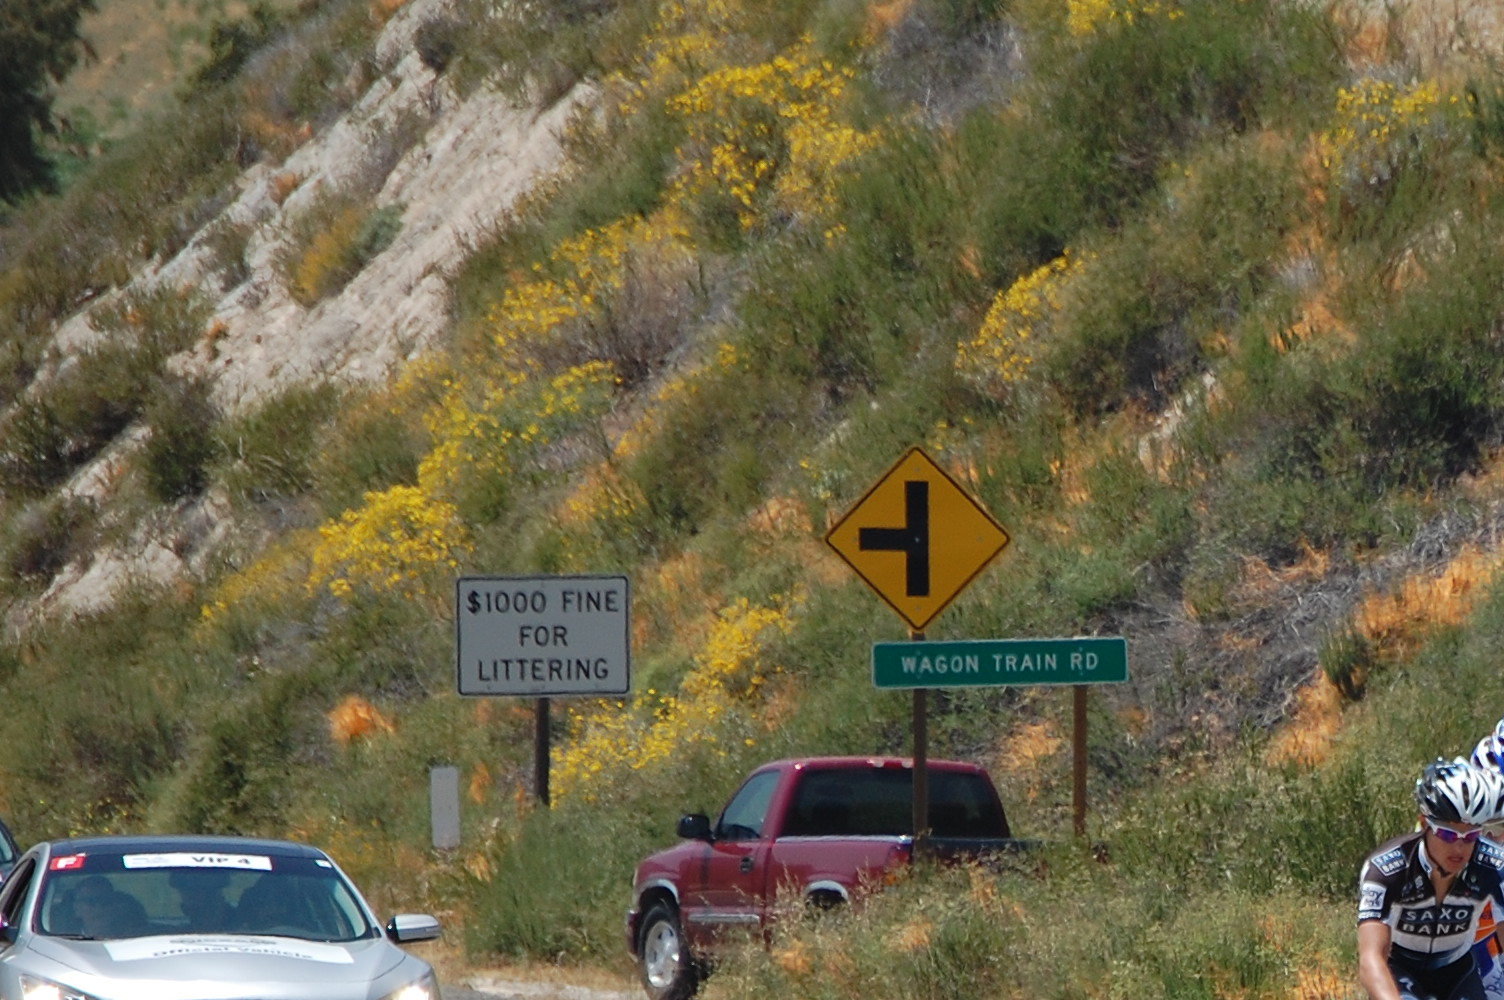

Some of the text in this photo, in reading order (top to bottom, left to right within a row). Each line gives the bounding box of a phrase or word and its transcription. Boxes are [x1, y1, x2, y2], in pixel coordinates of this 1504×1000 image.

[467, 590, 619, 614] $1000 FINE
[519, 625, 568, 647] FOR
[478, 658, 609, 682] LITTERING
[901, 652, 1099, 674] WAGON TRAIN RD
[237, 857, 251, 865] 4
[1406, 908, 1469, 921] SAXO
[1401, 921, 1468, 935] BANK
